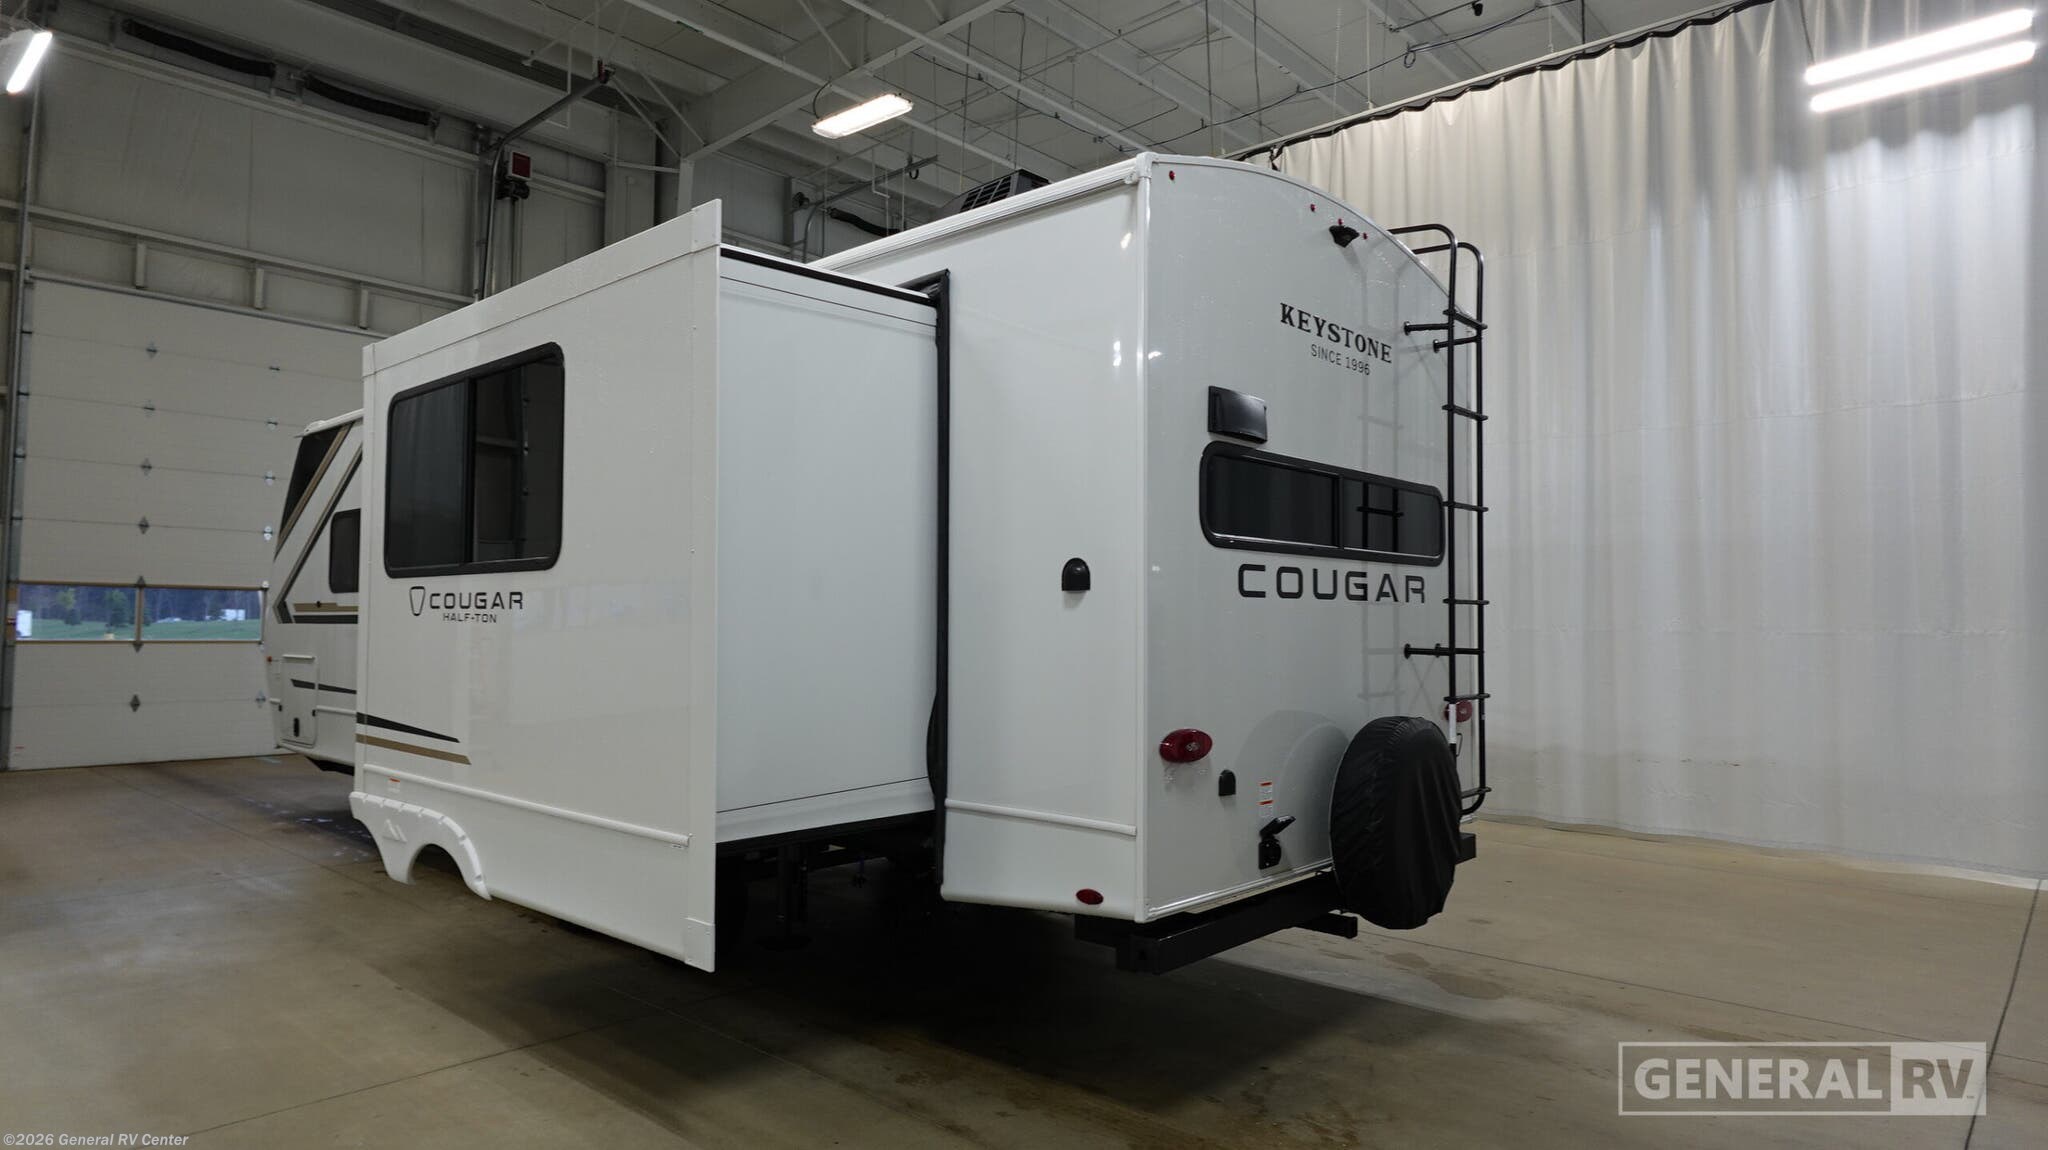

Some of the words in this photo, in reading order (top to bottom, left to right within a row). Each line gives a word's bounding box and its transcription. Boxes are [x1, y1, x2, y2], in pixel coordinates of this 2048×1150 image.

[1280, 302, 1392, 363] KEYSTONE
[1311, 344, 1342, 366] SINCE
[1345, 356, 1371, 376] 1996
[1238, 563, 1425, 604] COUGAR
[430, 592, 523, 610] COUGAR
[443, 613, 497, 623] HALF-TON
